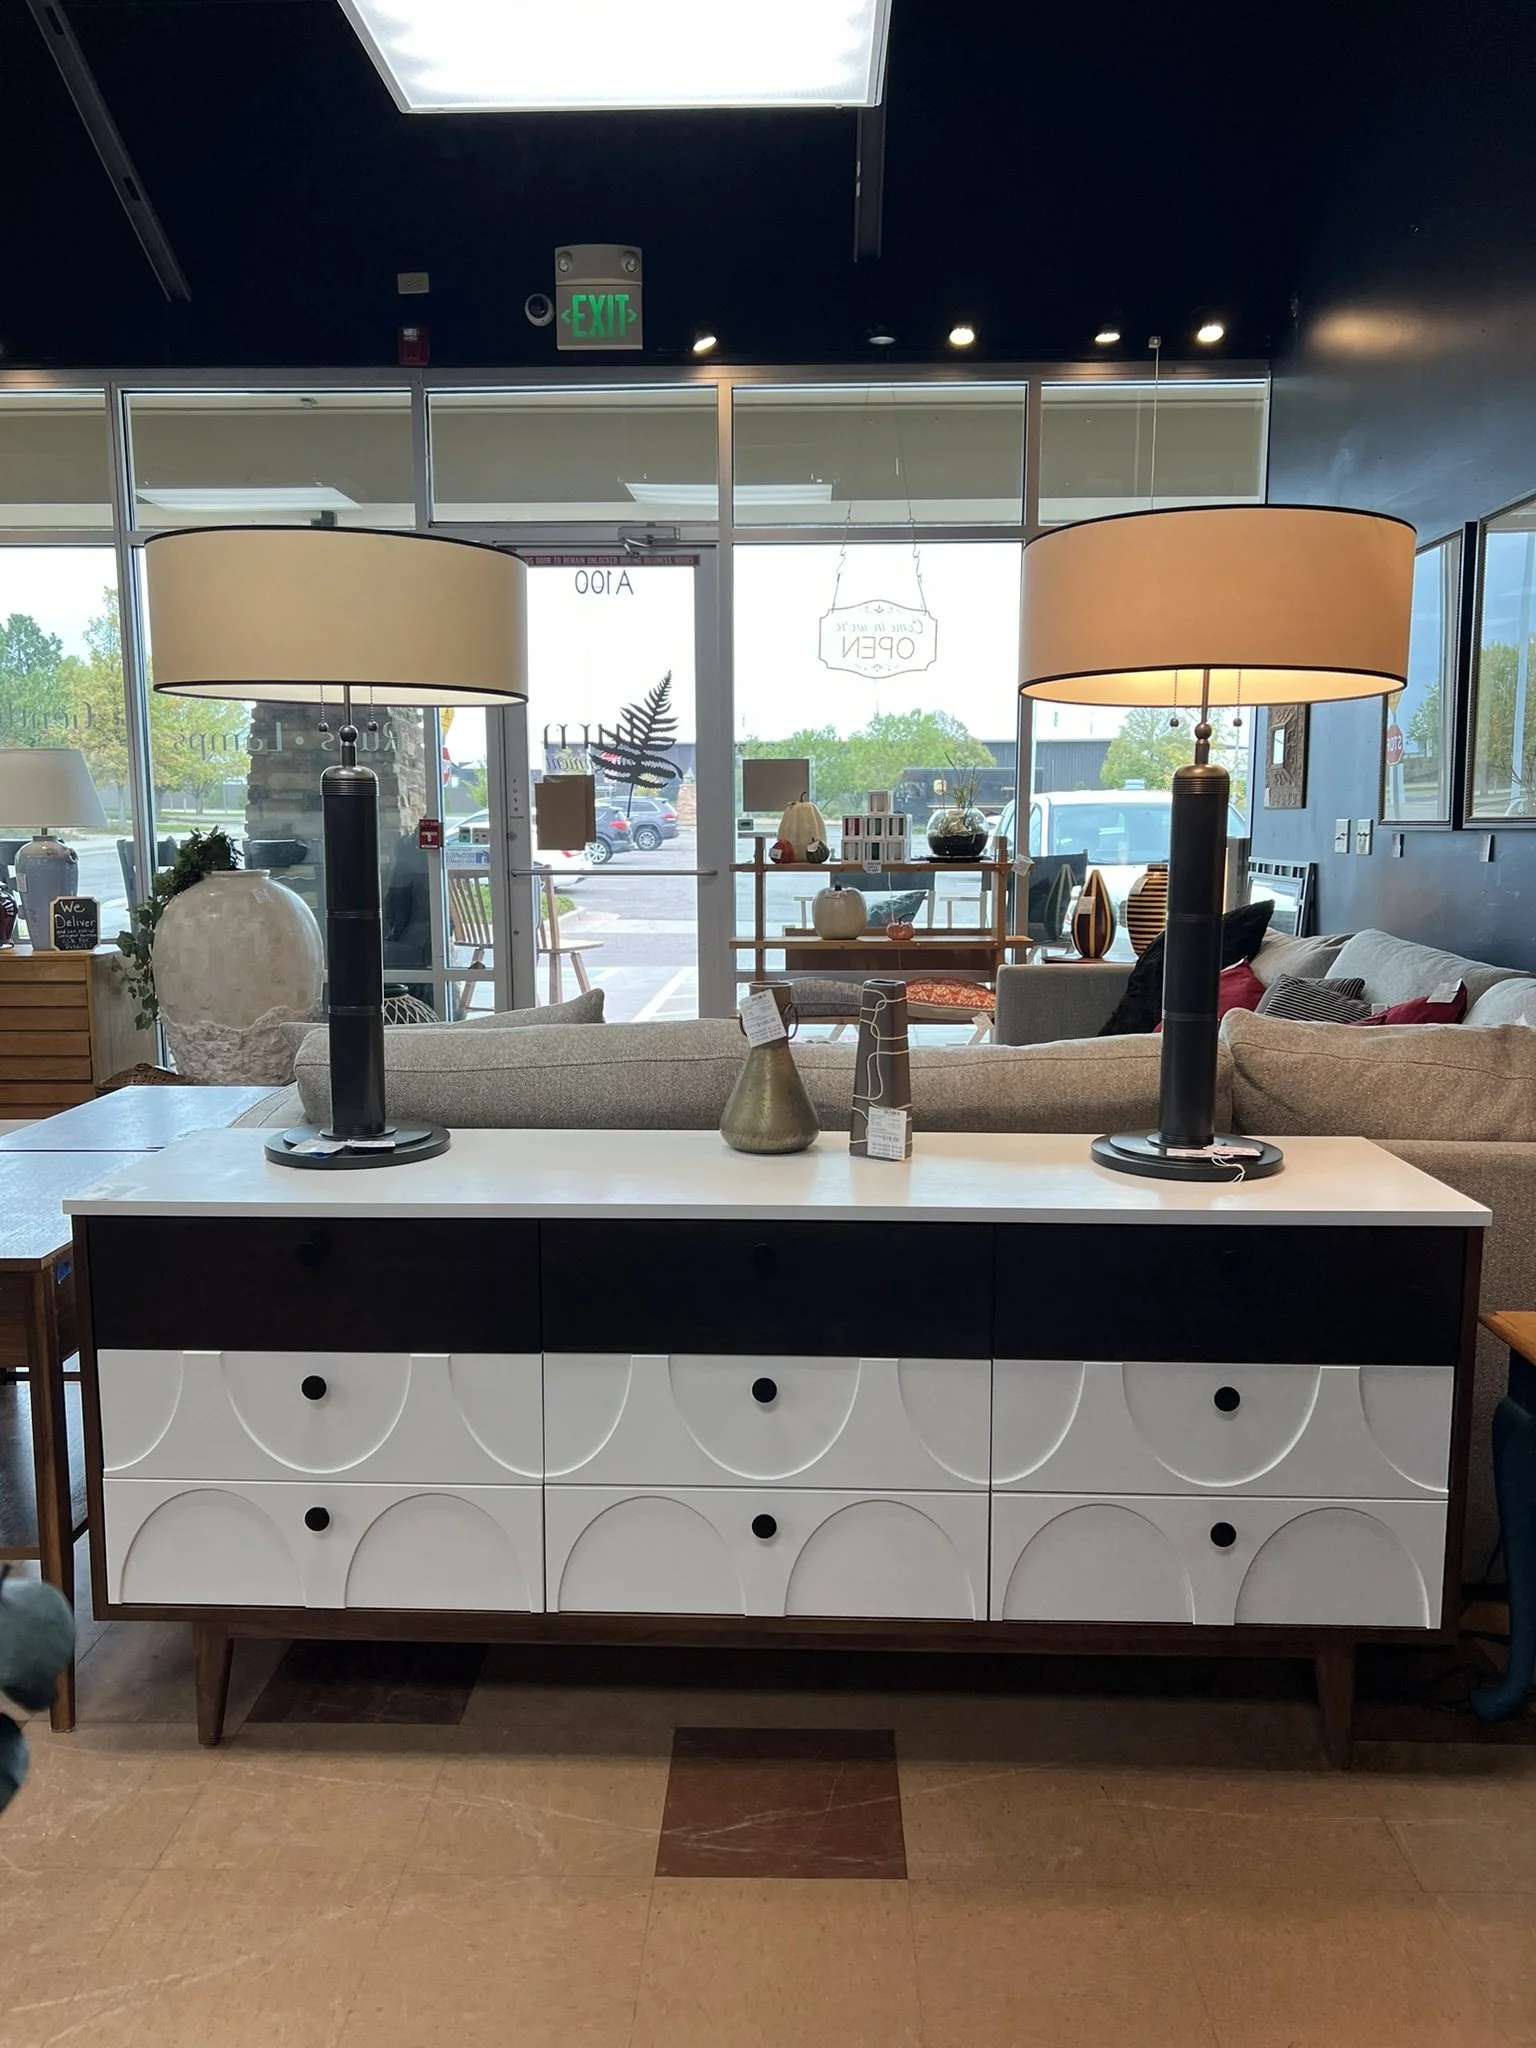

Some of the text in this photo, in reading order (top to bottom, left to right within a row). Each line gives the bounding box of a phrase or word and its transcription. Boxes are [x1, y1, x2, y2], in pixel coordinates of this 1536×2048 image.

[572, 294, 629, 338] EXIT
[60, 901, 86, 913] We
[54, 914, 95, 929] Deliver
